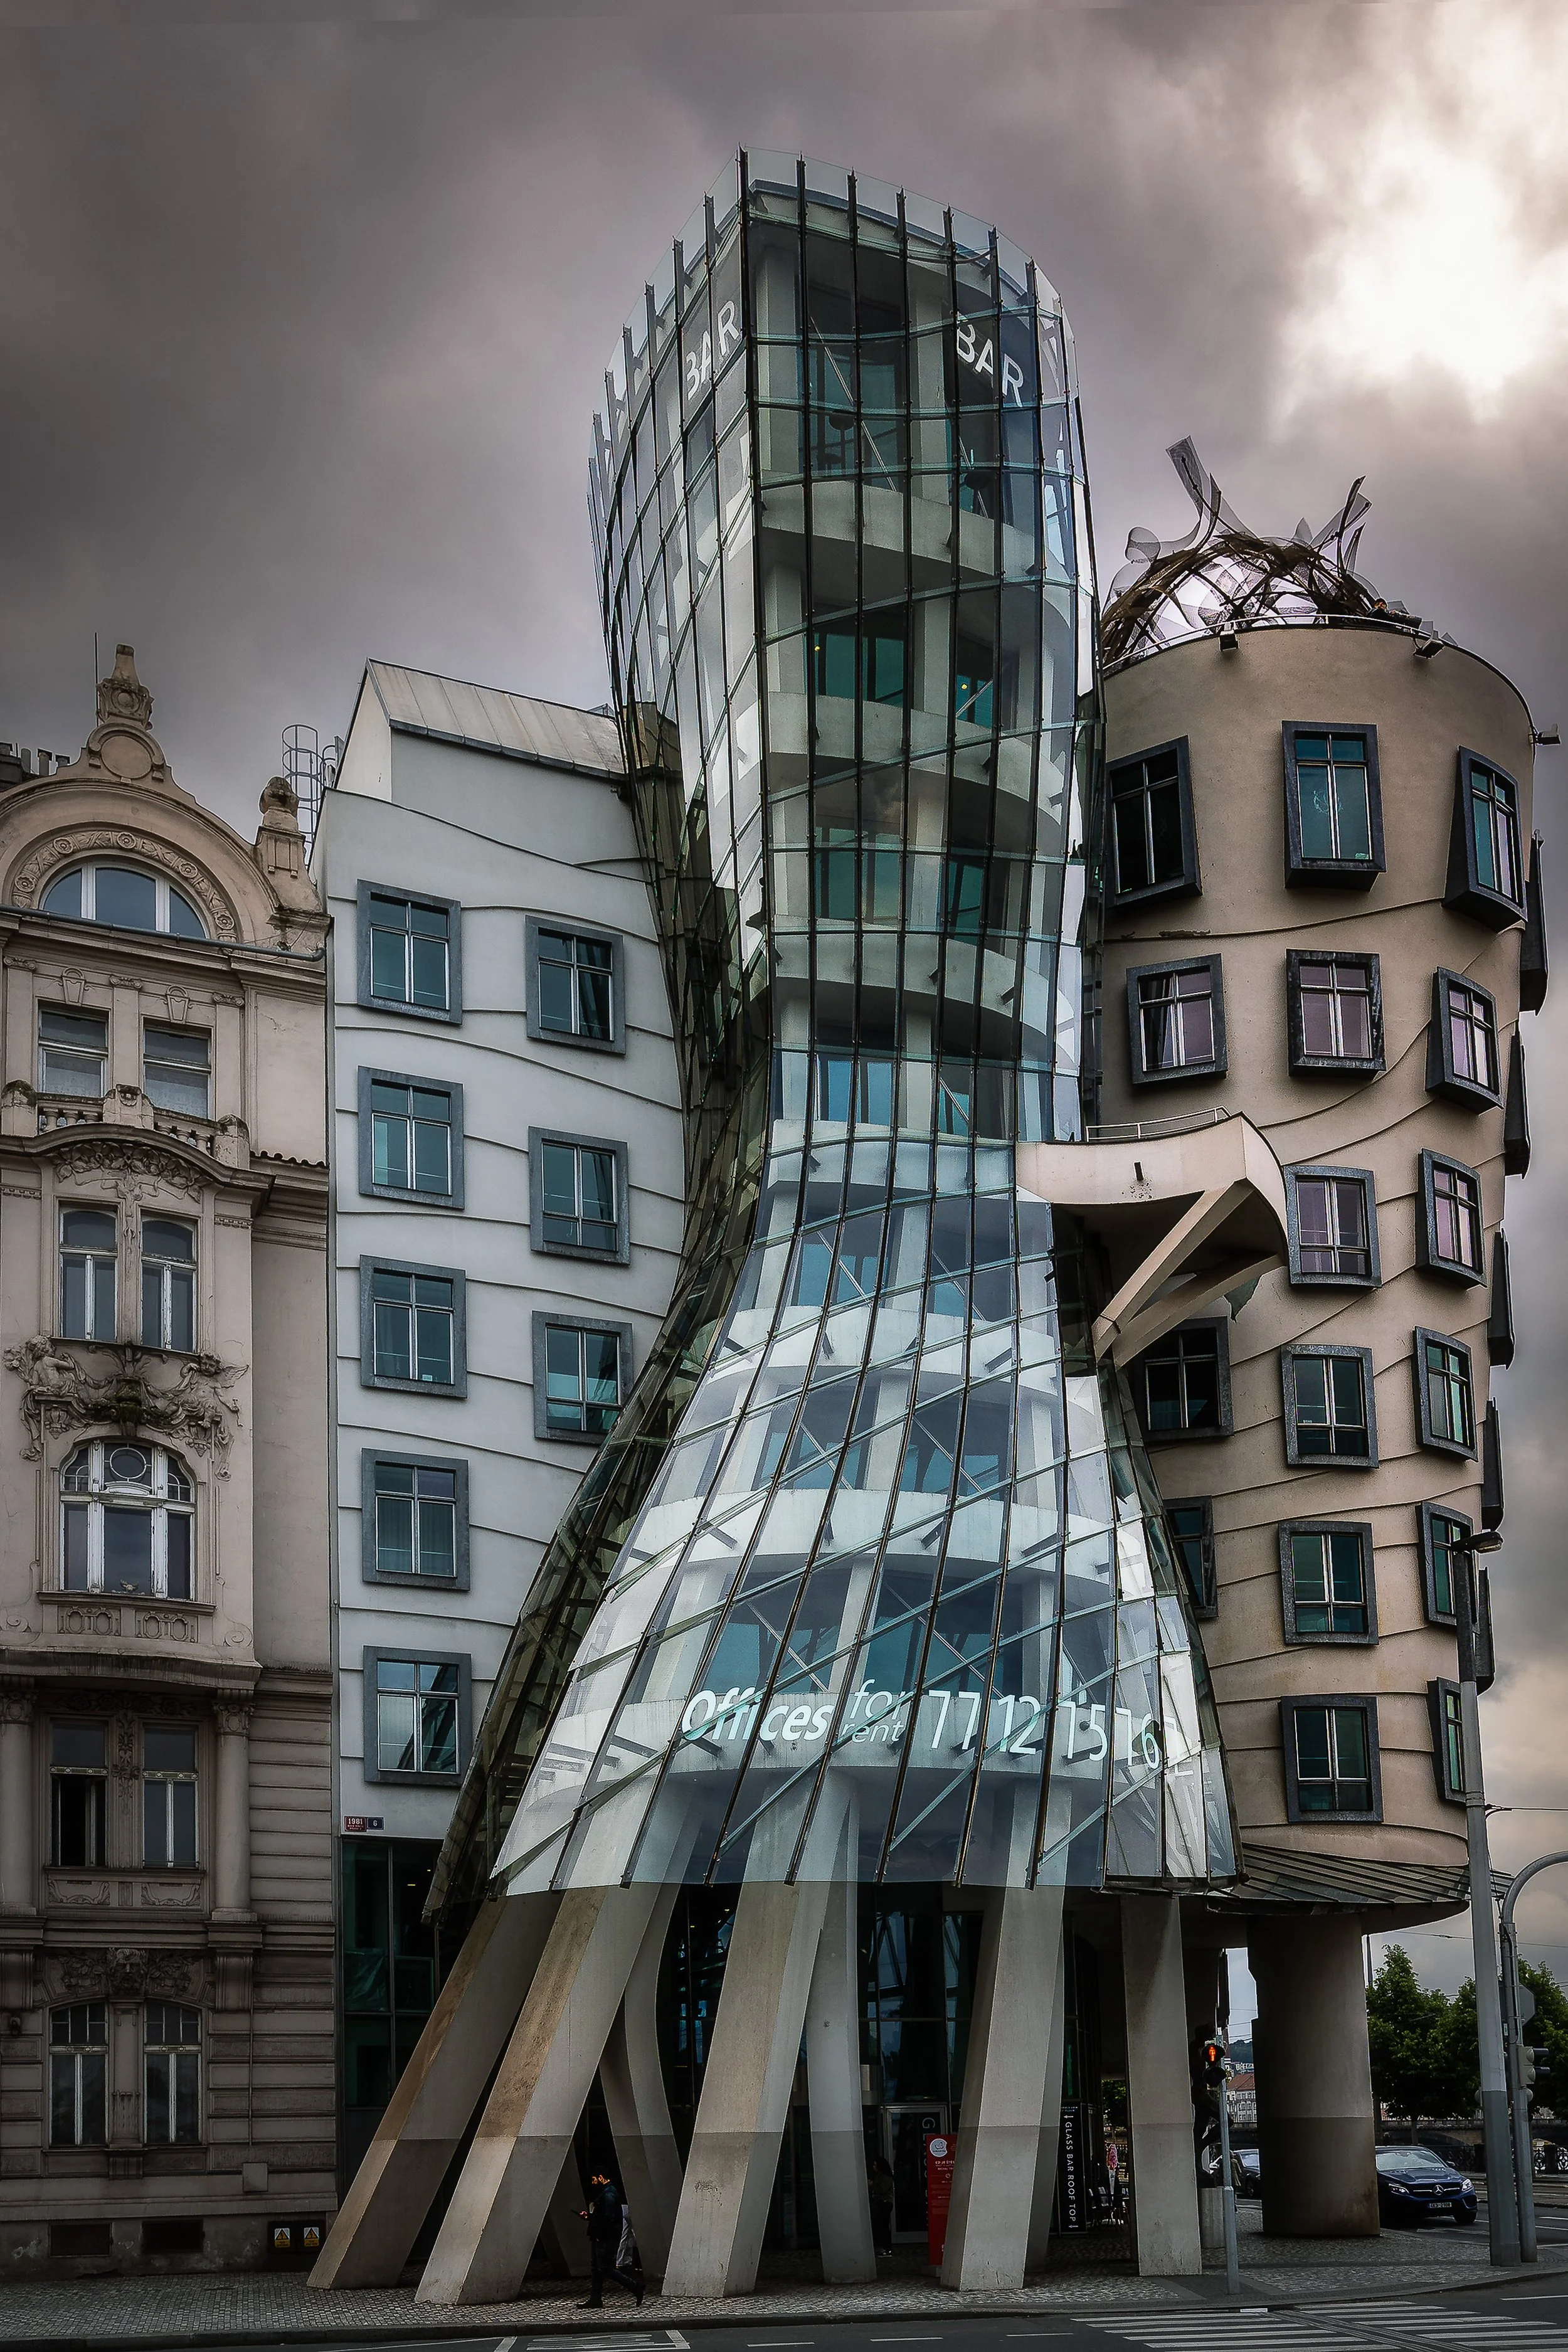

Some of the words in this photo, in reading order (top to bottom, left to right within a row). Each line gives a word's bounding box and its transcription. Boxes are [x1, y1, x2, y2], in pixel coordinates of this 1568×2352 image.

[956, 312, 1024, 408] BAR
[681, 1687, 835, 1741] Offices
[849, 1678, 914, 1720] for
[836, 1720, 904, 1743] rent
[1065, 2122, 1073, 2150] GLASS
